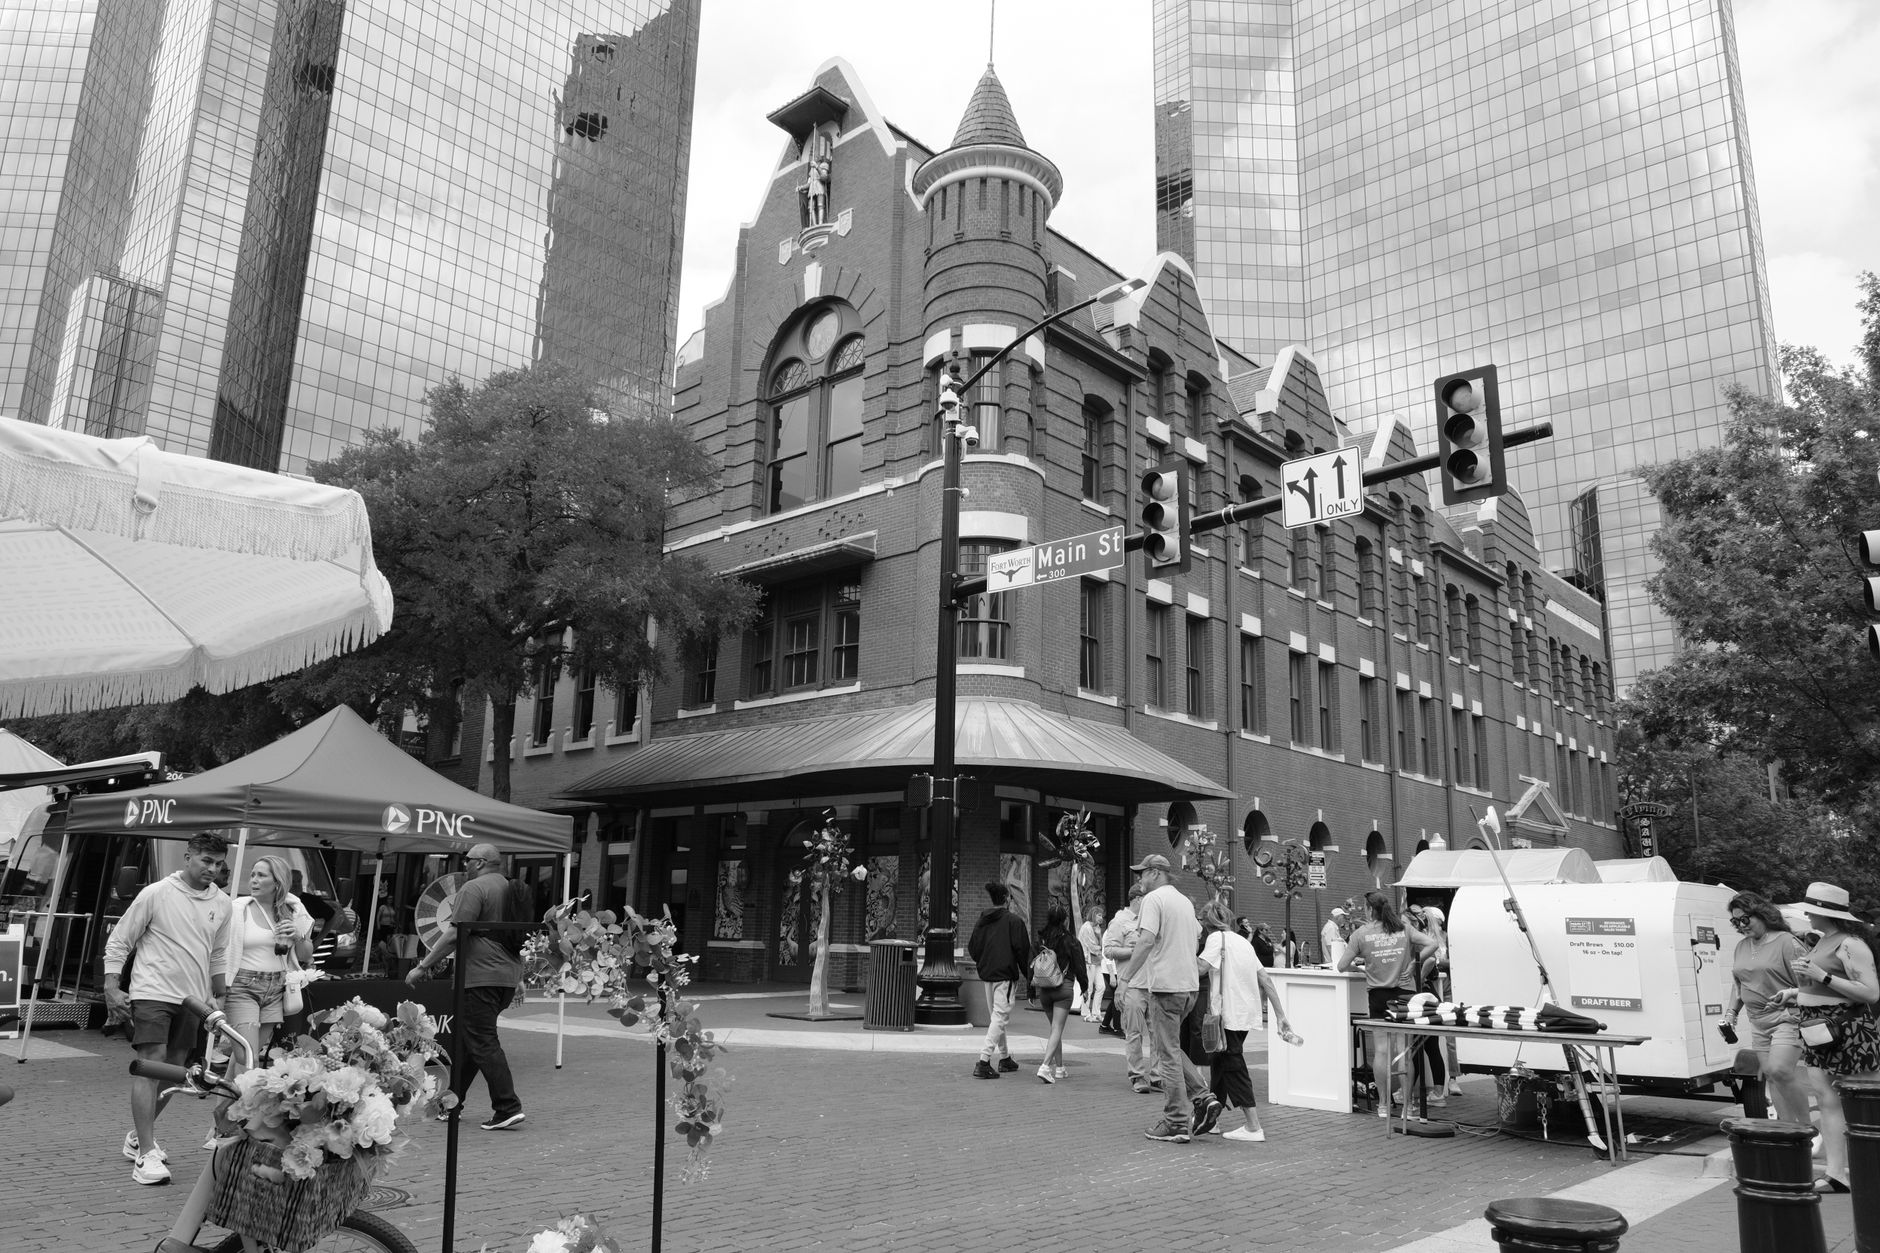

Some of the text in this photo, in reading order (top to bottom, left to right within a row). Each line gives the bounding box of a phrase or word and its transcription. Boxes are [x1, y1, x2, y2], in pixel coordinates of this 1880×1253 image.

[1327, 498, 1359, 515] ONLY
[1038, 531, 1121, 569] Main St
[1048, 568, 1066, 579] 300
[140, 798, 177, 824] PNC
[415, 808, 475, 838] PNC
[1640, 817, 1652, 857] SAUC
[1581, 998, 1632, 1008] DRAFT BEER
[429, 1014, 454, 1034] NK
